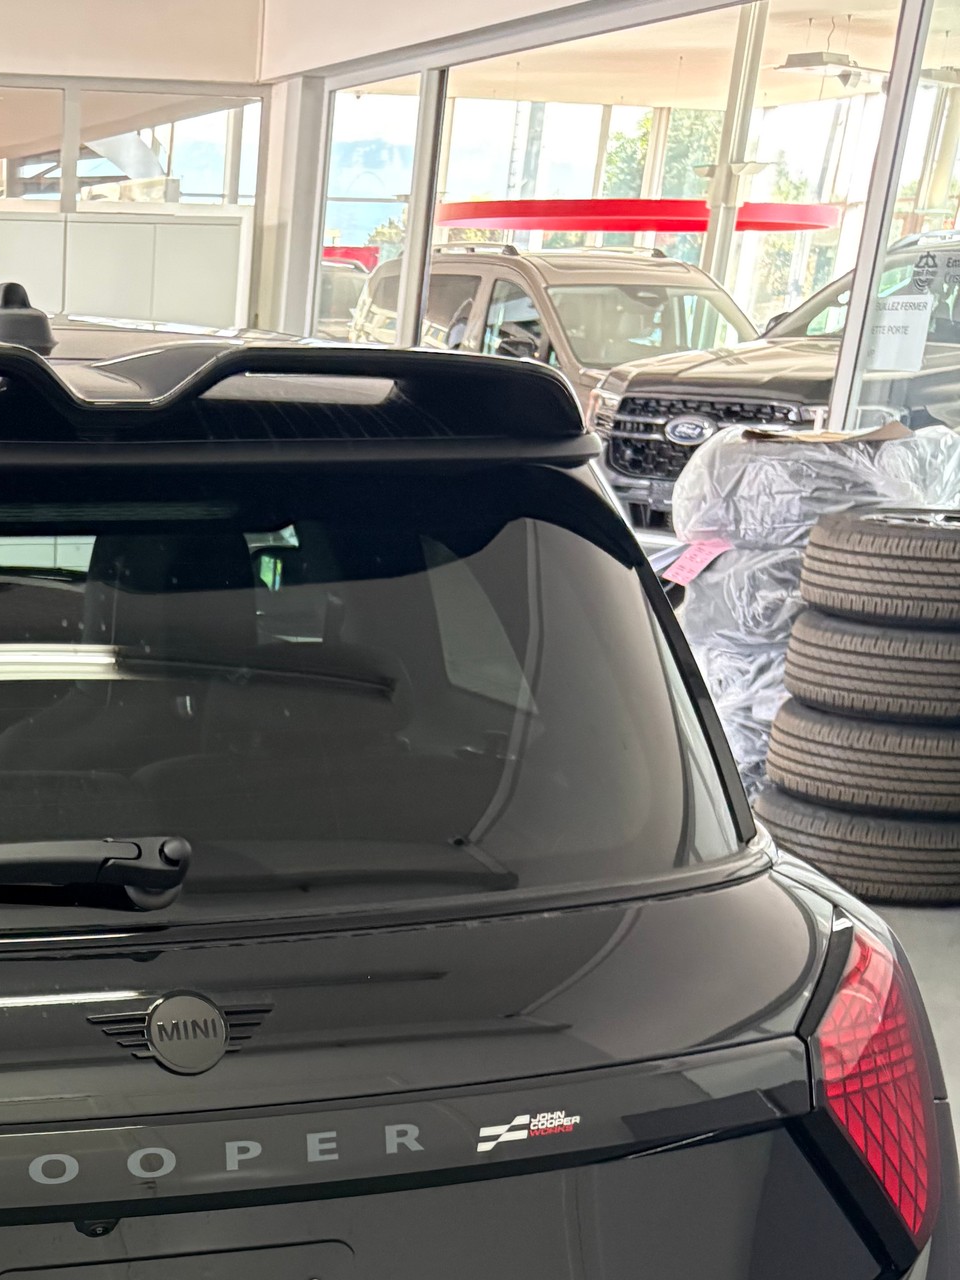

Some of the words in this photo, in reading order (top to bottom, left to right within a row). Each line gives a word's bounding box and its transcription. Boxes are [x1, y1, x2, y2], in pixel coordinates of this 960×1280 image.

[156, 1018, 218, 1041] MINI
[529, 1115, 580, 1130] COOPER
[530, 1110, 565, 1122] JOHN
[529, 1124, 574, 1137] WORKS
